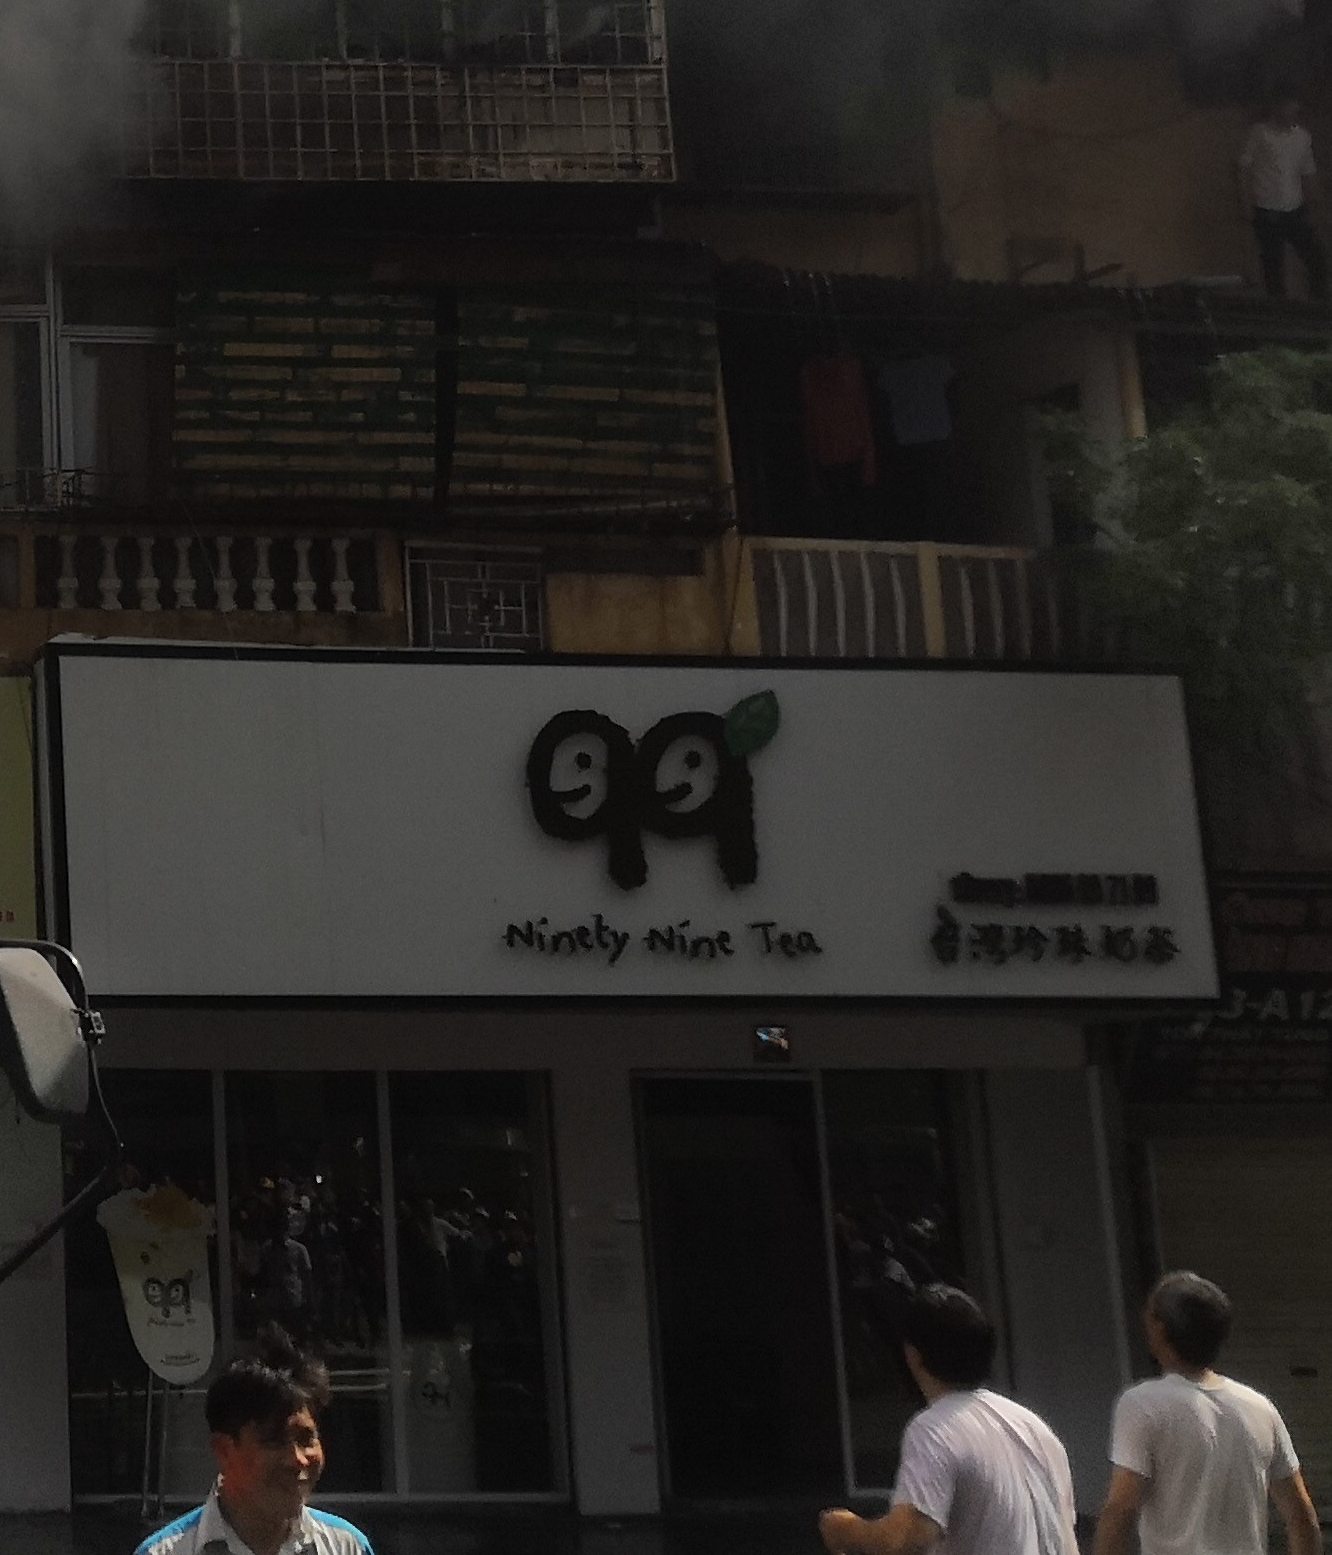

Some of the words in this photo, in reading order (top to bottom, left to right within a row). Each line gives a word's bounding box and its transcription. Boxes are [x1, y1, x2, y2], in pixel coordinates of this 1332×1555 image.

[502, 913, 630, 967] Ninety
[643, 919, 734, 961] Nine
[747, 922, 823, 958] Tea
